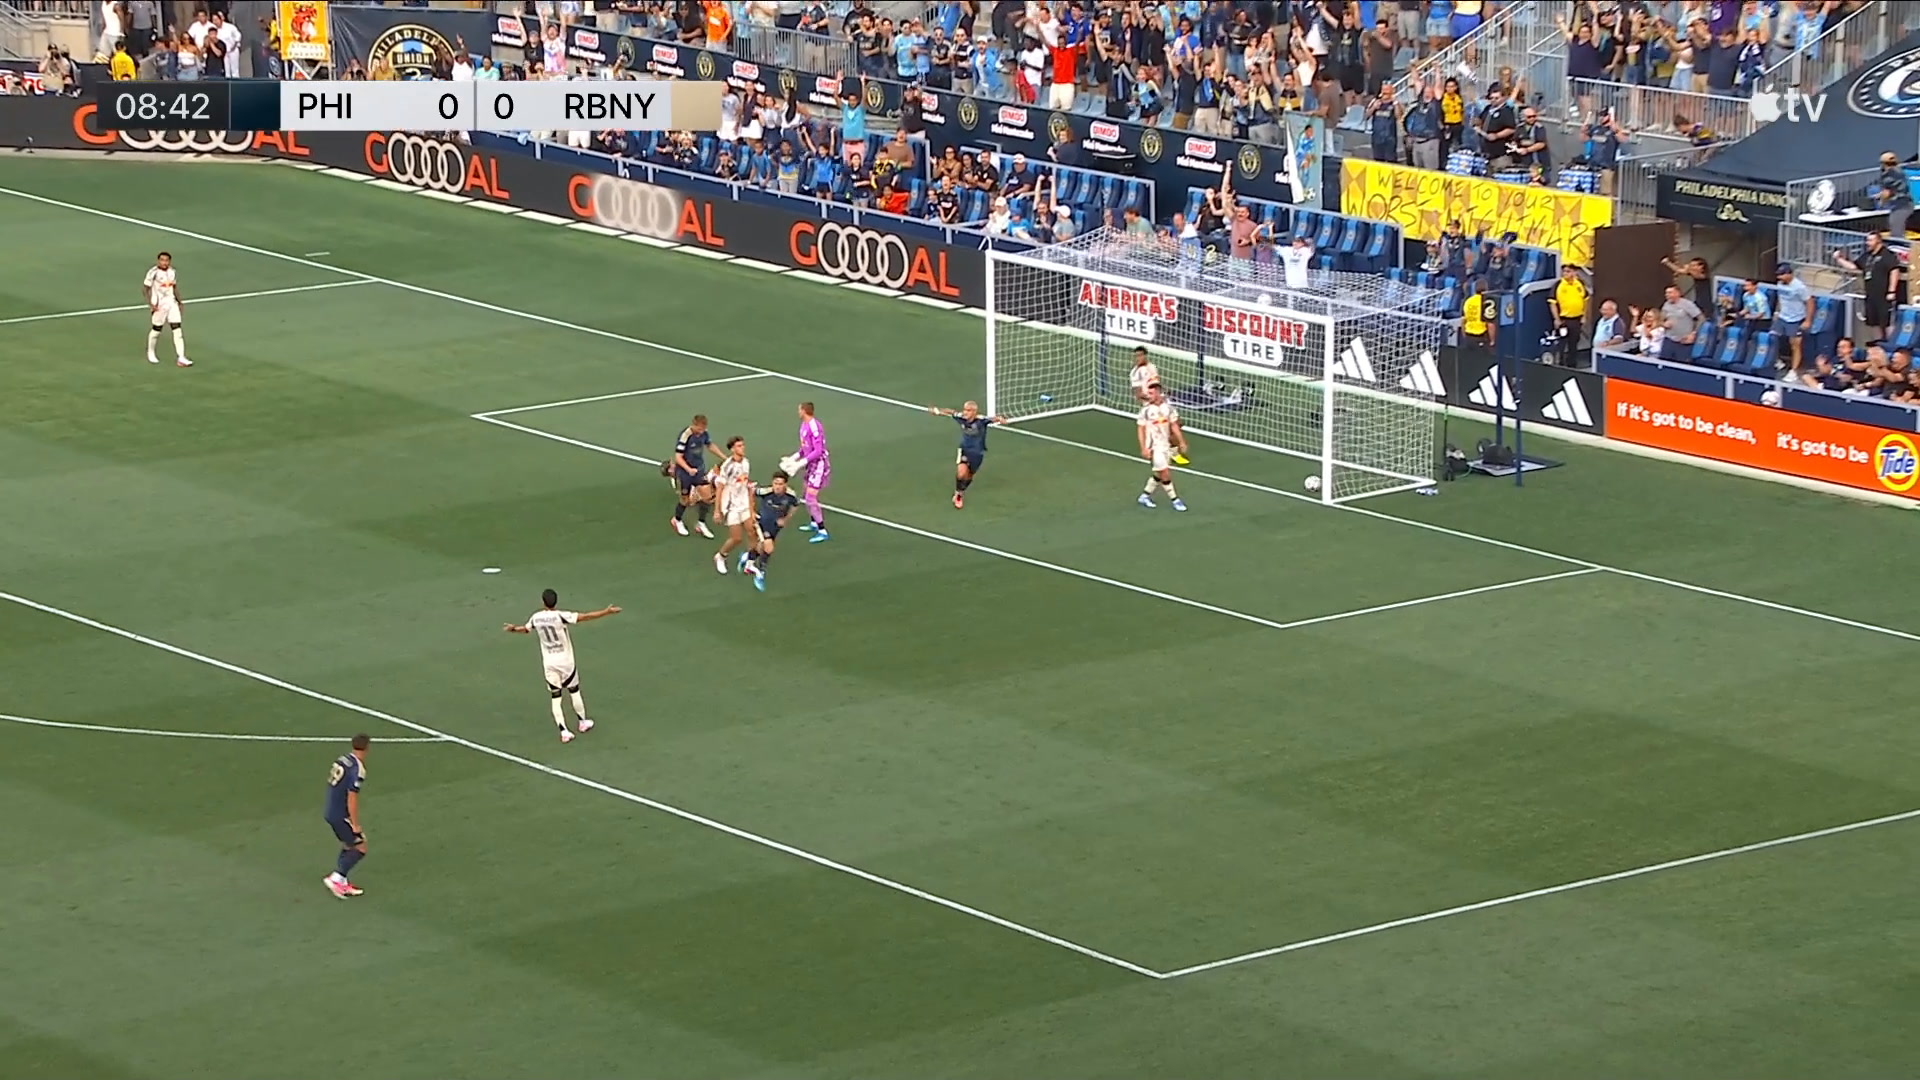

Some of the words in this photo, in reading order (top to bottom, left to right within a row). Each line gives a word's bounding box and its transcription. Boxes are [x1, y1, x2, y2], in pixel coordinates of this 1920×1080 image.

[396, 53, 430, 64] UNION
[1377, 170, 1464, 198] WELCOME
[1472, 182, 1493, 201] TO
[1505, 191, 1556, 212] YOUR
[1675, 180, 1758, 204] PHILADELPHIA
[1346, 193, 1432, 230] WORST
[1445, 206, 1607, 259] NIGHTMAR
[1080, 283, 1177, 320] AMERICA'S
[1107, 313, 1148, 335] TIRE
[1203, 305, 1306, 346] DISCOUNT
[1231, 338, 1275, 360] TIRE
[1617, 402, 1628, 417] If
[1629, 403, 1650, 422] it's
[1652, 412, 1676, 426] got
[1677, 415, 1693, 430] to
[1695, 416, 1714, 434] be
[1716, 422, 1756, 445] clean,
[1777, 432, 1799, 450] it's
[1801, 440, 1827, 456] got
[1829, 443, 1847, 459] to
[1848, 445, 1869, 463] be
[1879, 447, 1915, 478] Tide
[541, 625, 560, 642] 11
